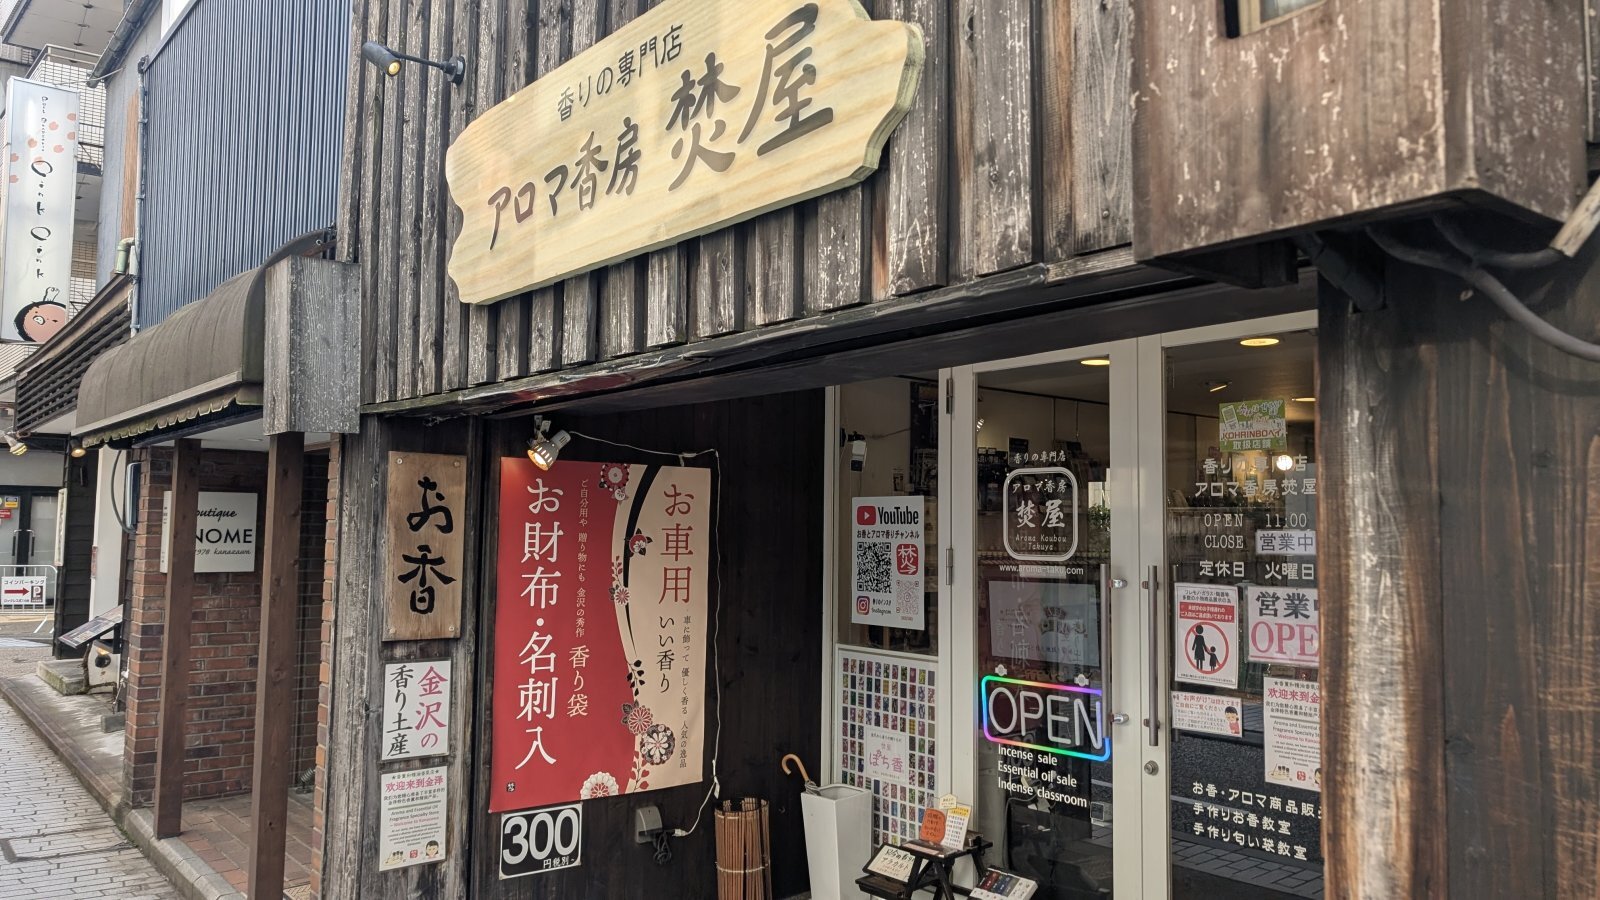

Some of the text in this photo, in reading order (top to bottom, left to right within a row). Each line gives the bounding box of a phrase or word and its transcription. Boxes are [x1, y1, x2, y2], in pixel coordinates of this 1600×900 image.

[557, 24, 684, 122] 香りの専門店
[487, 2, 834, 251] アロマ香房 焚屋
[1013, 449, 1067, 465] 香りの専門店
[1012, 478, 1068, 494] アロマ香房
[1194, 478, 1317, 498] アロマ香房焚屋
[877, 505, 920, 526] YouTube
[1015, 498, 1066, 529] 焚屋
[1203, 512, 1308, 528] OPEN 11:00
[397, 475, 457, 615] お香
[658, 483, 695, 606] お車用
[856, 529, 921, 540] お香とアロマ香りチャンネル
[1015, 533, 1036, 542] Aroma
[1203, 534, 1244, 550] CLOSE
[1258, 532, 1314, 553] 営業中
[1199, 559, 1315, 581] 定休日 火曜日
[566, 478, 591, 718] ご自分用や 贈り物にも 金沢の秀作 香り袋
[1256, 591, 1319, 620] 営業
[515, 477, 564, 771] お財布・名刺入
[656, 615, 676, 695] いい香り
[386, 664, 415, 757] 香り土産
[415, 665, 449, 749] 金沢の
[988, 686, 1103, 750] OPEN
[998, 743, 1058, 767] Incense sale
[385, 775, 444, 793] 欢迎来到金泽
[997, 763, 1078, 788] Essential oil sale
[997, 776, 1088, 808] Incense classroom
[1193, 802, 1292, 836] 手作りお香教室
[502, 808, 580, 866] 300
[1193, 822, 1308, 861] 手作り匂い袋教室
